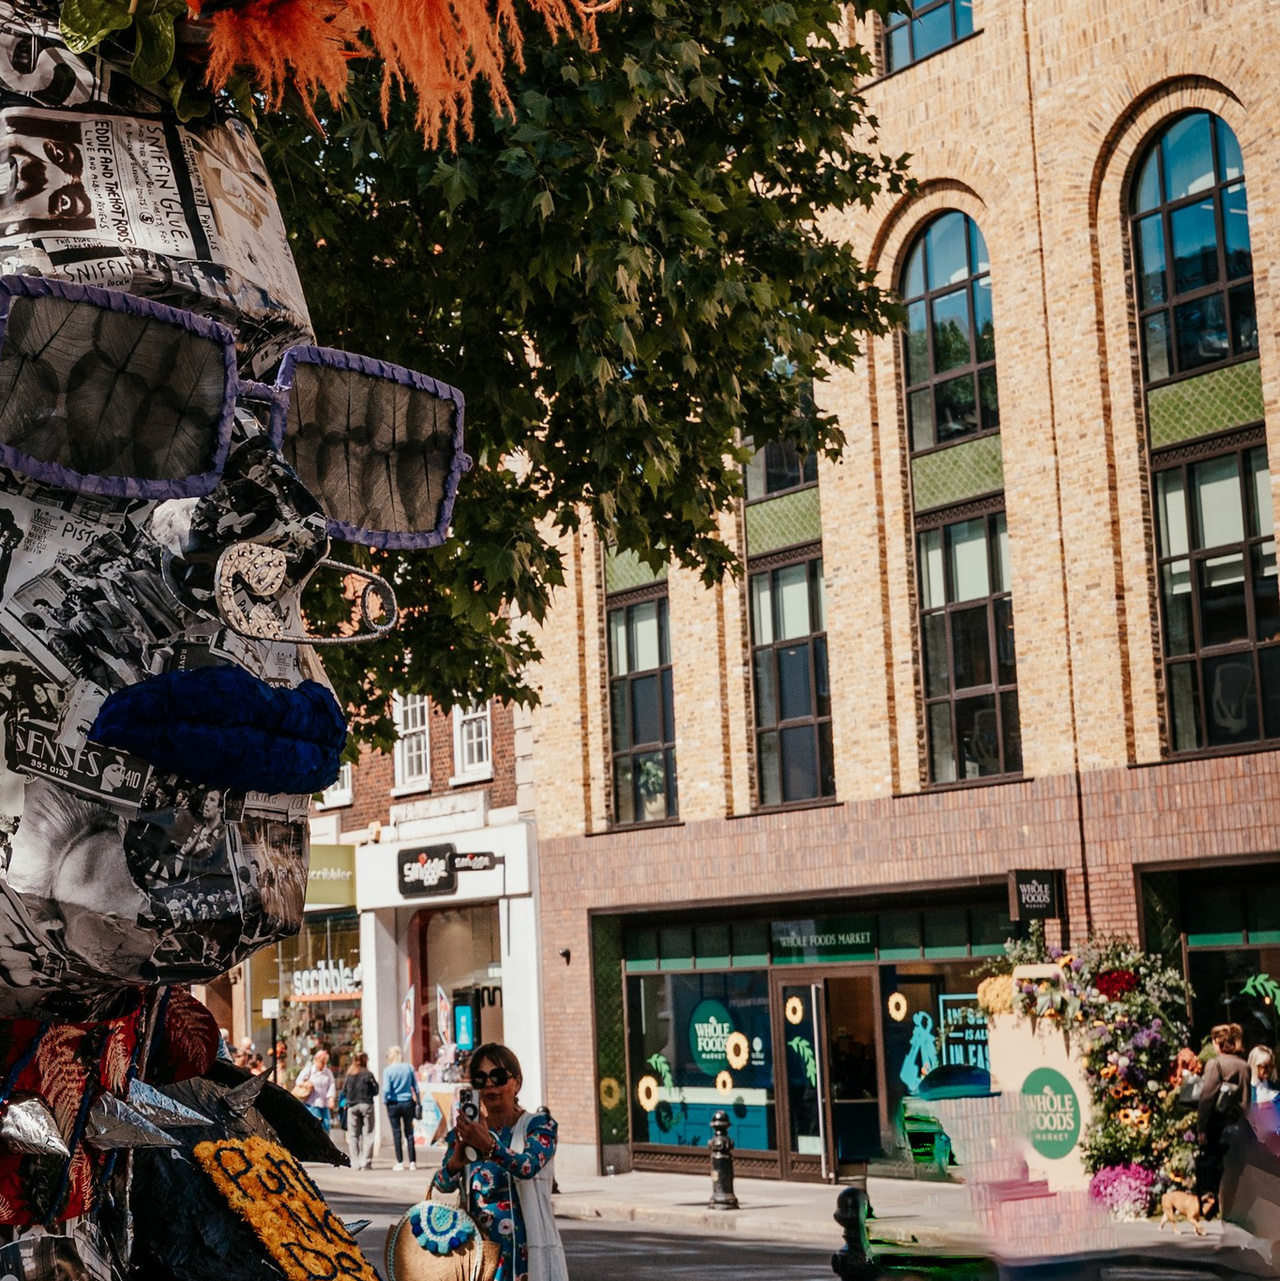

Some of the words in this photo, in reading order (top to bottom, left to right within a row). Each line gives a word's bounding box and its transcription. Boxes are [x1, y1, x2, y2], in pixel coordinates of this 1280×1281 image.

[84, 130, 96, 152] LIVE
[95, 121, 113, 157] EDDIE
[88, 156, 98, 171] AND
[100, 157, 114, 179] AND
[147, 125, 179, 195] SNIFFIN'
[91, 174, 103, 200] ALBUM
[200, 214, 219, 252] PHYLLIS
[30, 759, 48, 771] 352
[49, 765, 69, 779] 0192
[1019, 882, 1050, 895] WHOLE
[1022, 893, 1050, 904] FOODS
[780, 933, 808, 948] WHOLE
[810, 933, 836, 947] FOODS
[838, 931, 871, 945] MARKET
[695, 1019, 730, 1037] WHOLE
[698, 1037, 728, 1052] FOODS
[1024, 1092, 1074, 1113] WHOLE
